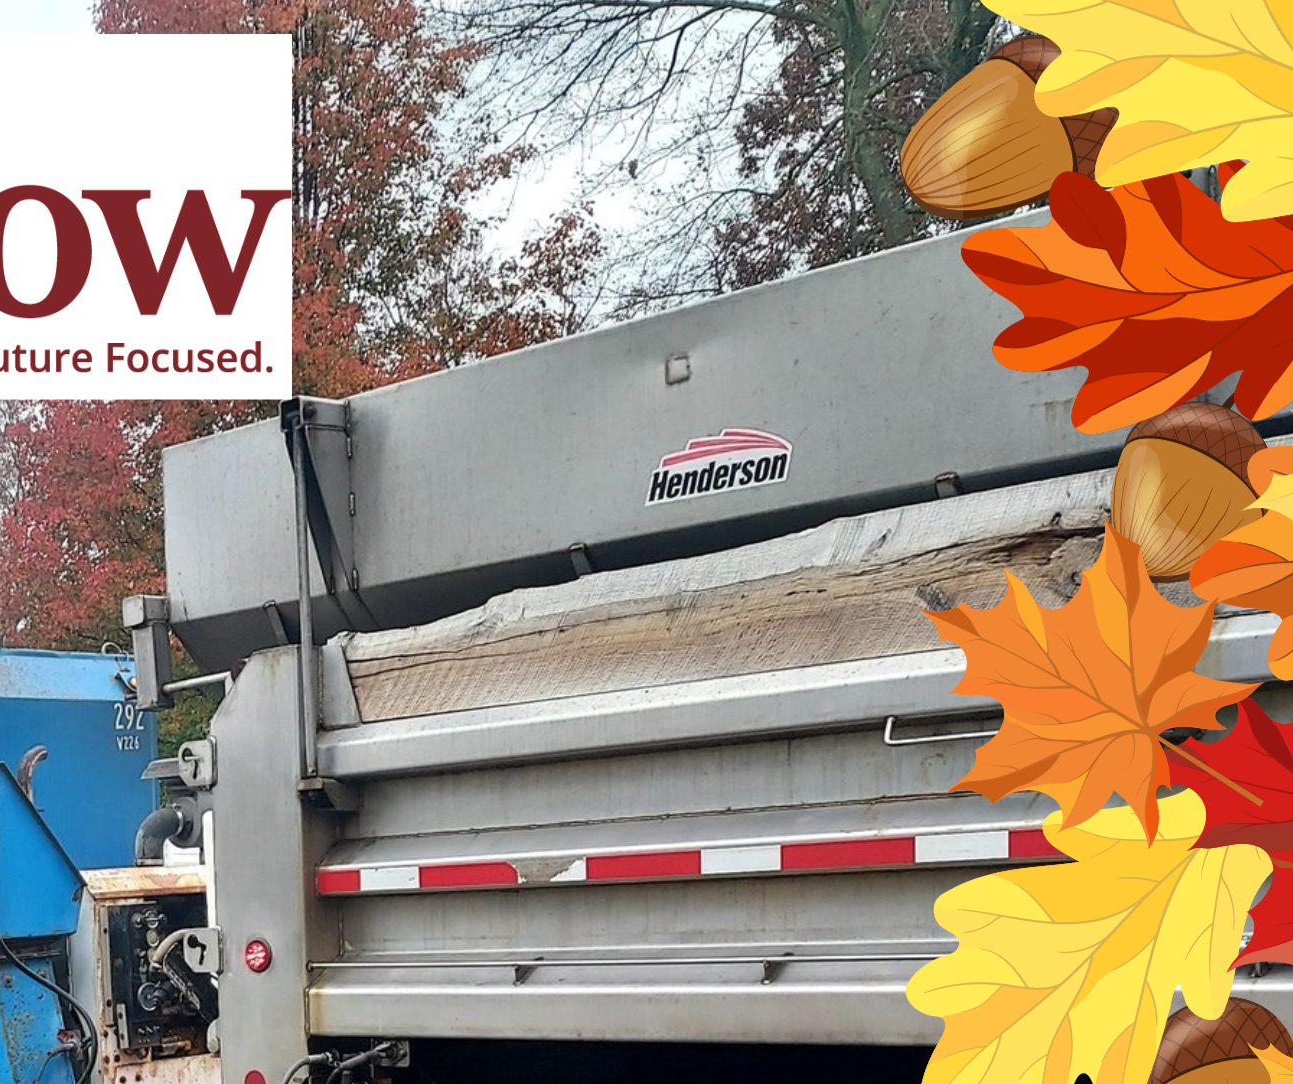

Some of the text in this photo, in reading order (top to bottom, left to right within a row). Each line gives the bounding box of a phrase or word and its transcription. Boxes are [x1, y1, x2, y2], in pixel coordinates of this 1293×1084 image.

[648, 453, 789, 502] Henderson
[113, 702, 145, 730] 292
[116, 735, 140, 751] V226
